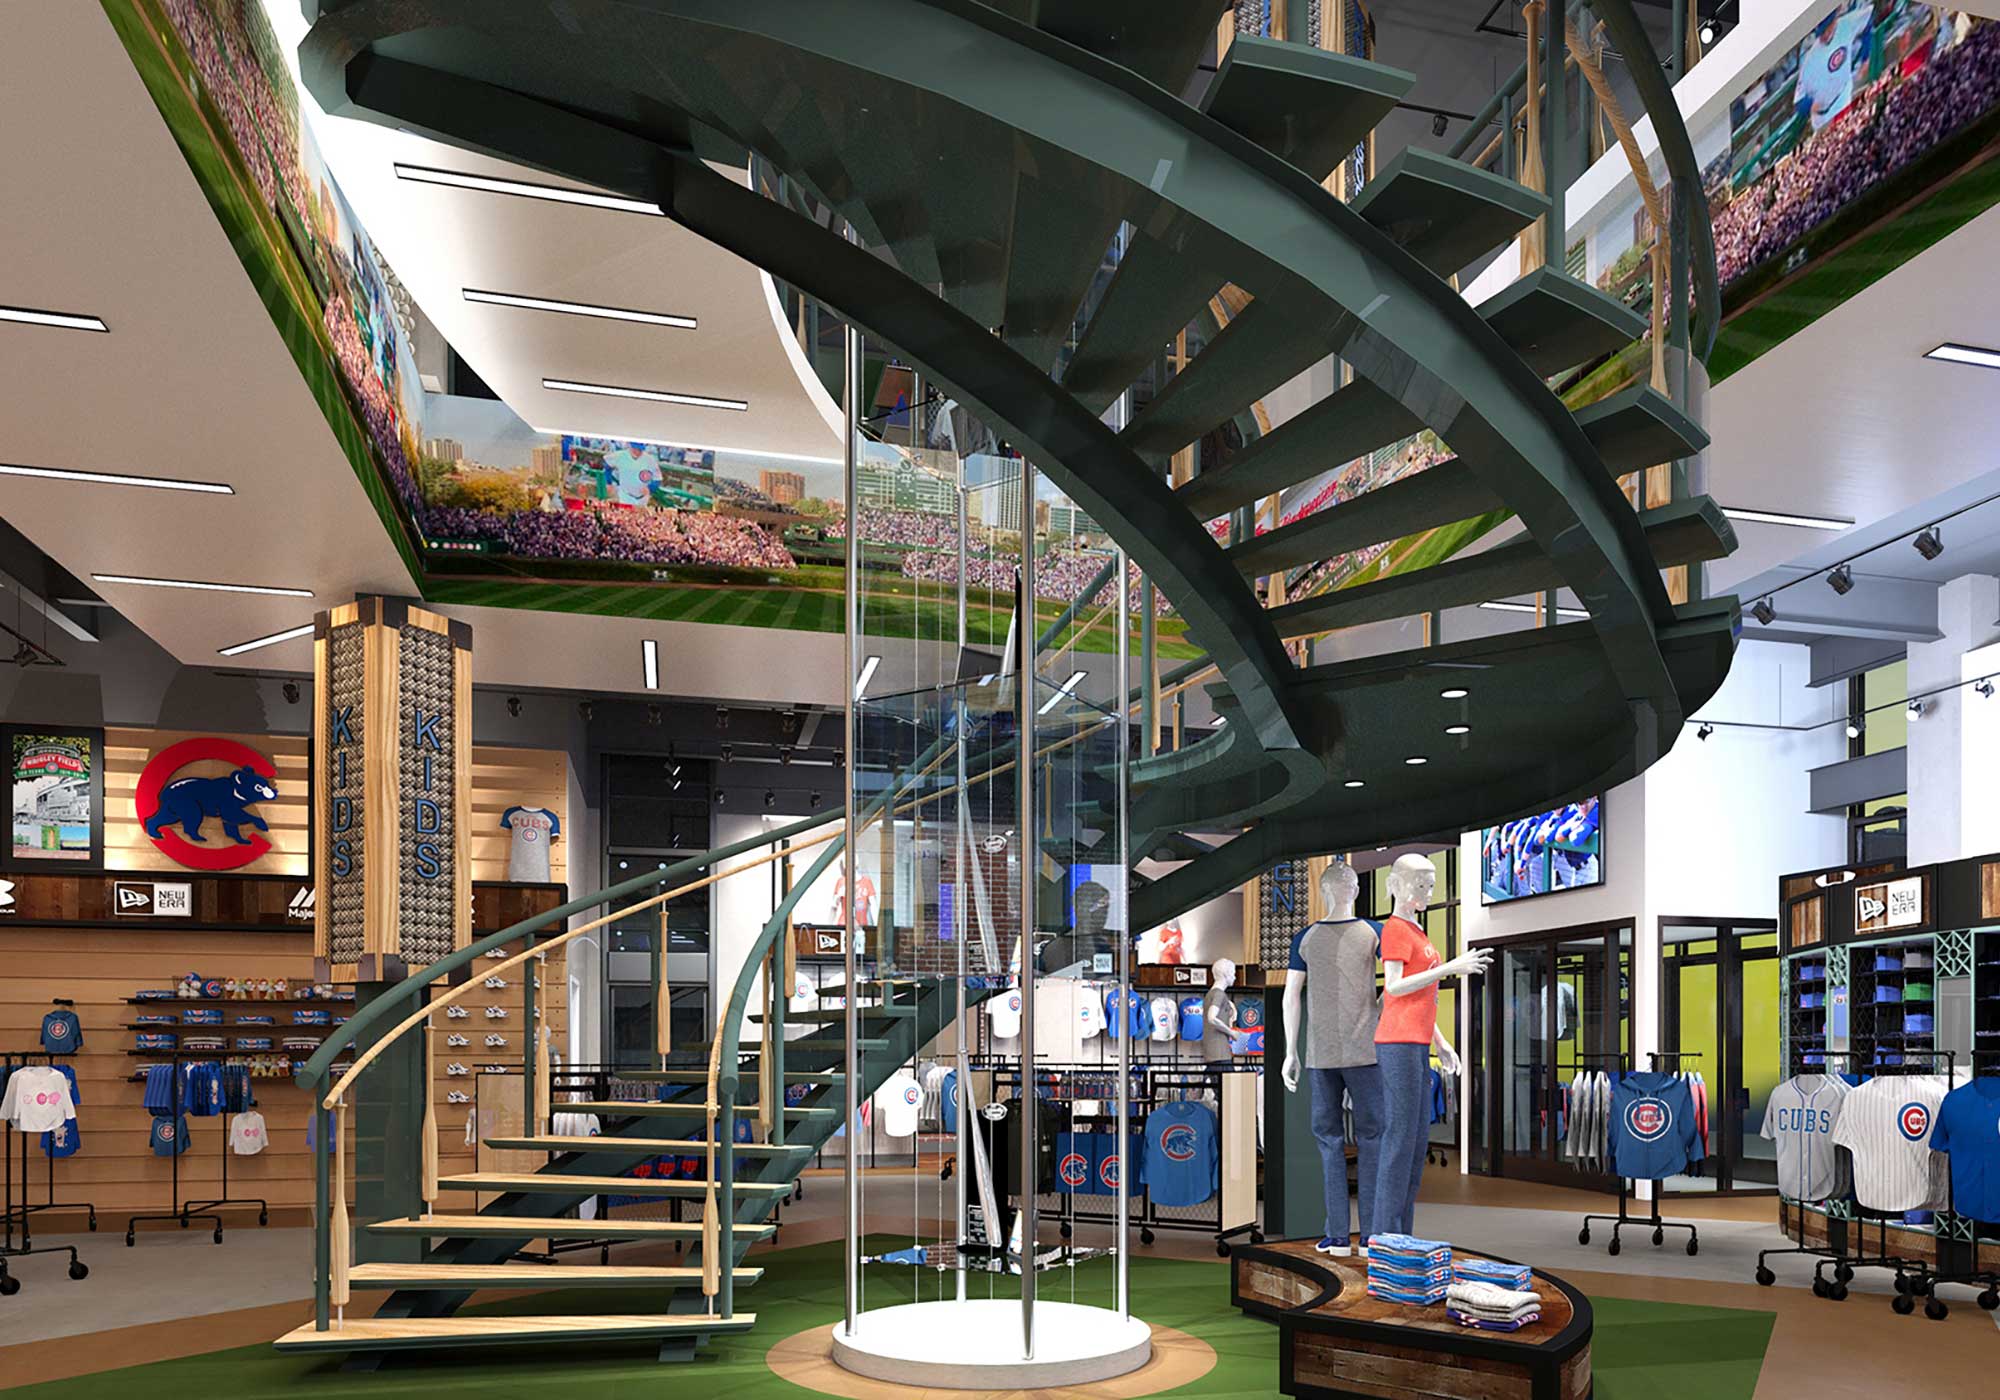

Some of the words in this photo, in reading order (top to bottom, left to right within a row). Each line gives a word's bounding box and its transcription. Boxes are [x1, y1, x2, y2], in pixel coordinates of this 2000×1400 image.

[333, 706, 352, 877] KIDS
[415, 710, 441, 878] KIDS
[512, 816, 549, 831] CUBS
[159, 890, 185, 899] NEW
[1891, 889, 1916, 902] NEW
[159, 900, 185, 908] ERA
[1891, 901, 1916, 916] ERA
[288, 908, 315, 920] Maje
[1779, 1108, 1831, 1134] CUBS
